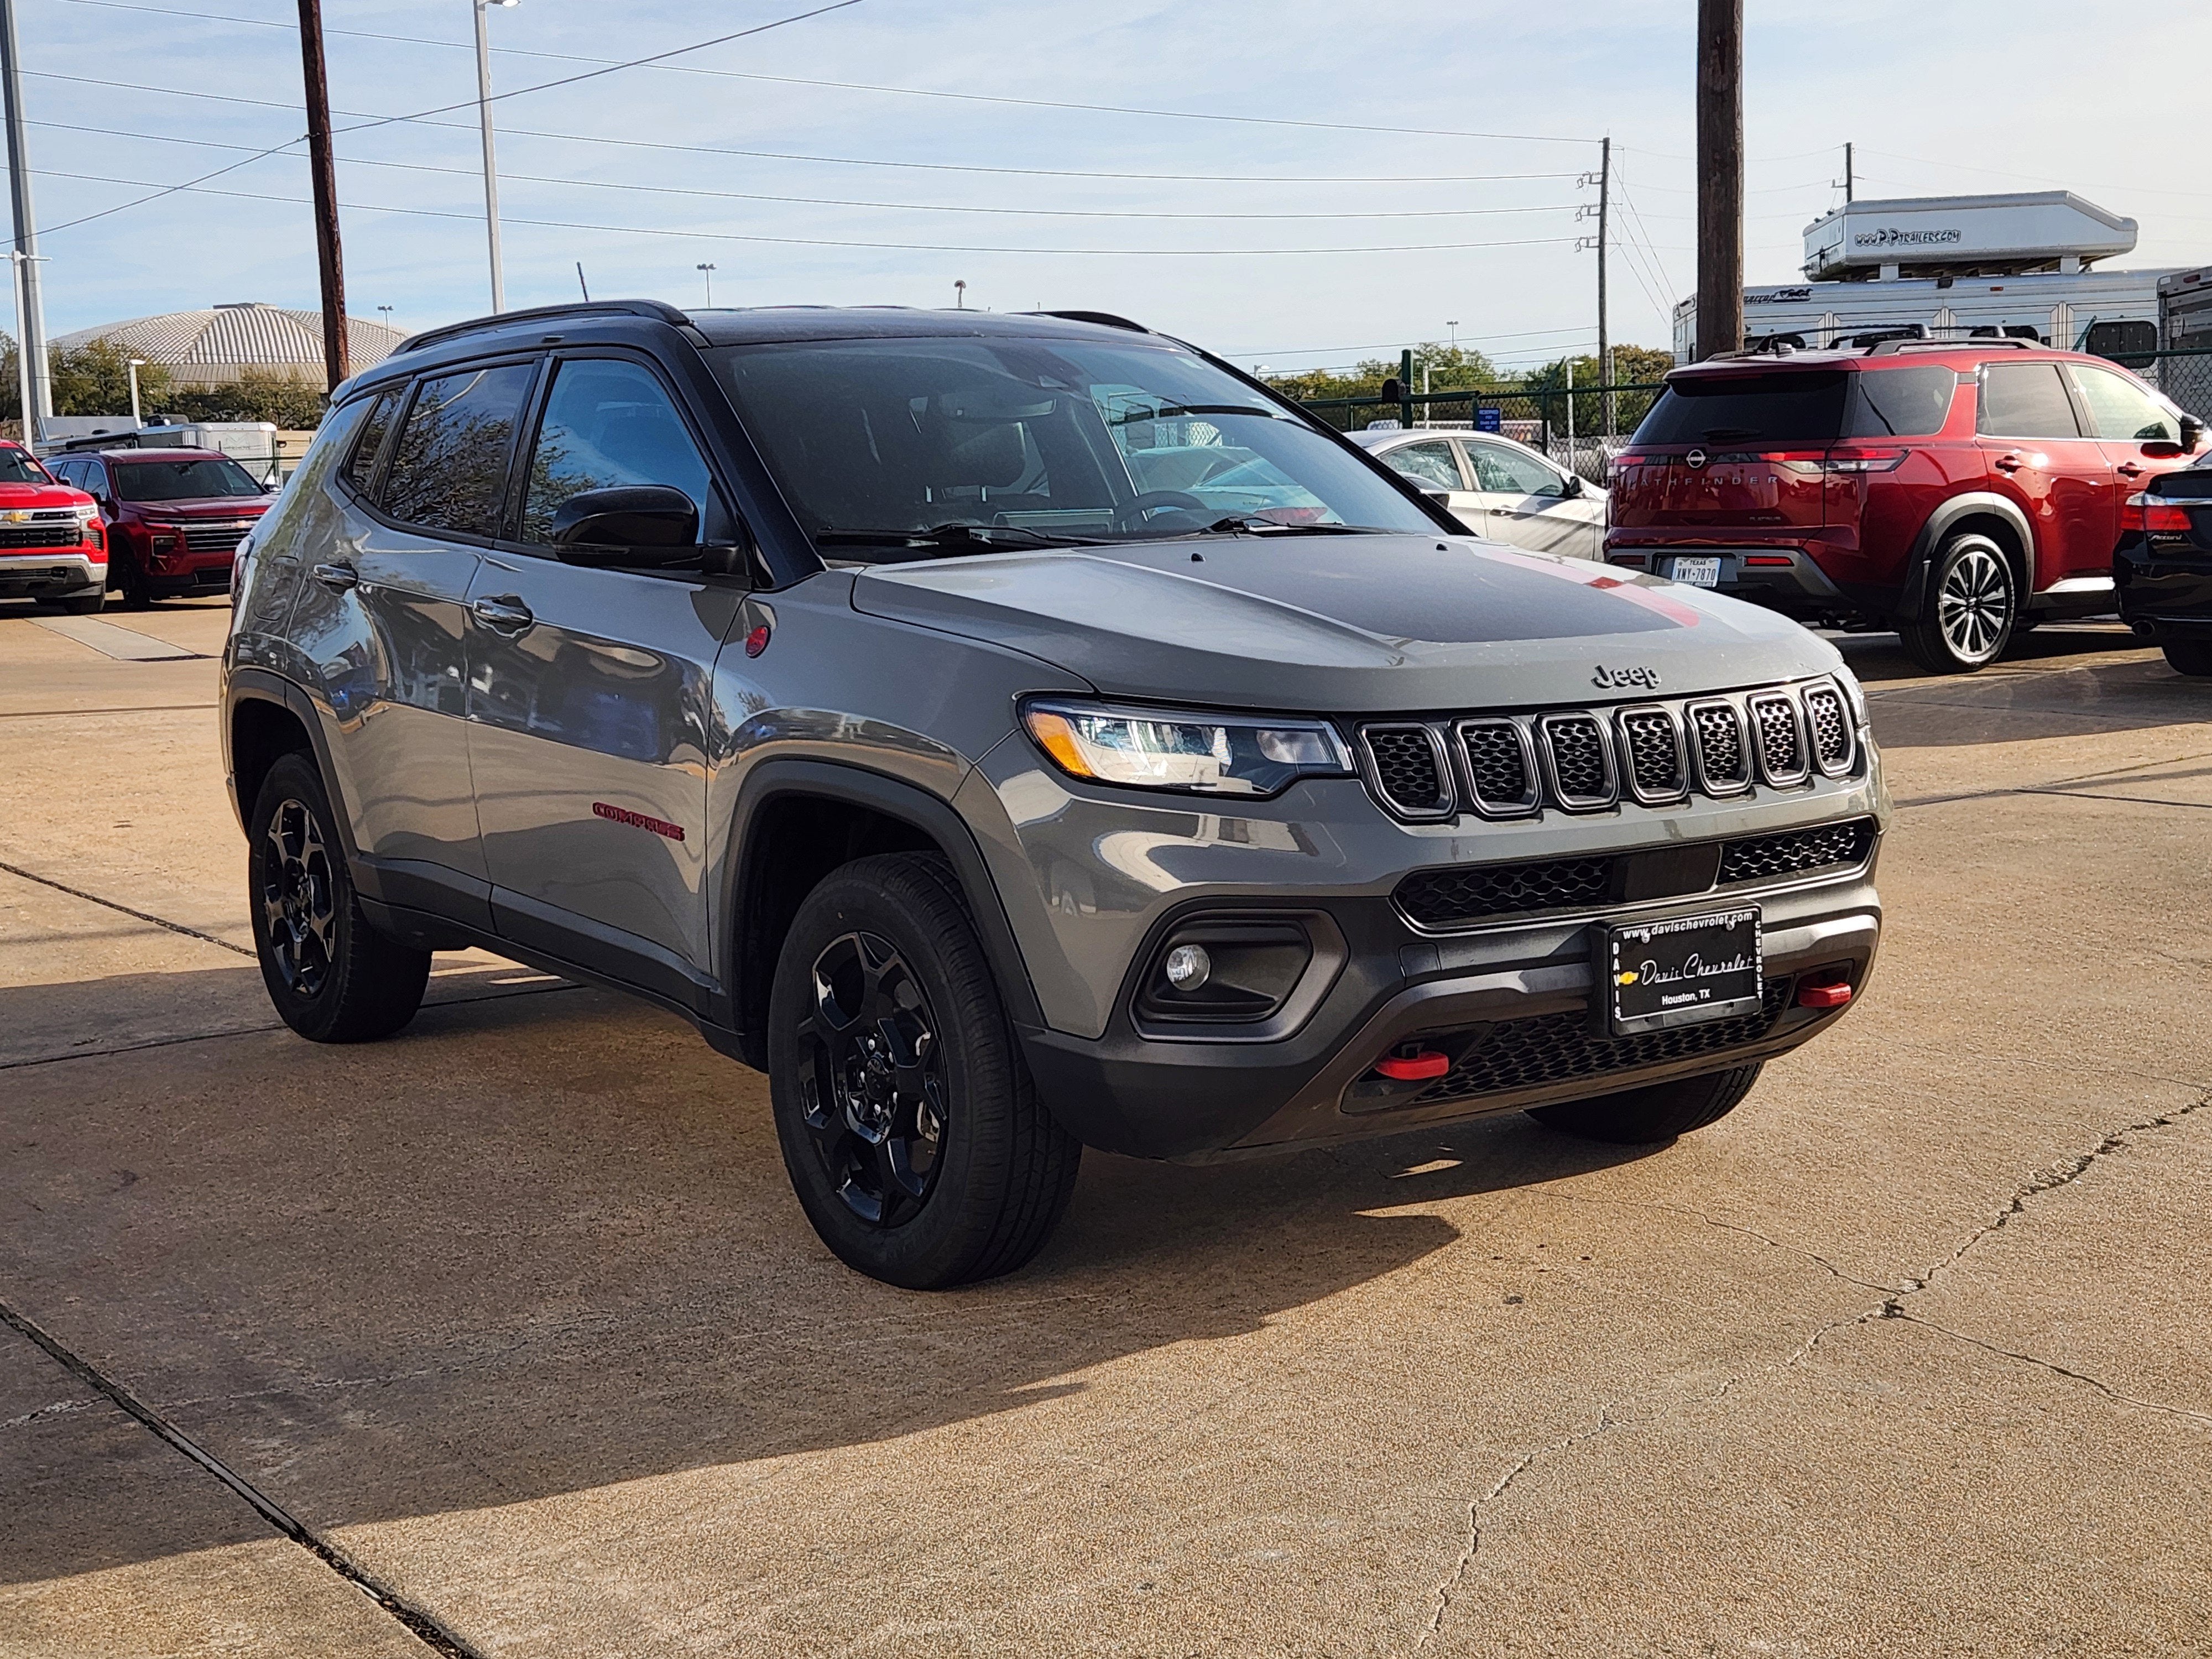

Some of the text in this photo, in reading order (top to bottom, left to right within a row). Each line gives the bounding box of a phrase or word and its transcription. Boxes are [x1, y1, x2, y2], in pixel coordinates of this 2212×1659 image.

[1590, 665, 1662, 690] Jeep
[592, 802, 685, 842] COMPASS
[1623, 912, 1752, 940] www.davischevrolet.com
[1640, 953, 1755, 985] Davis Chevrolet
[1755, 920, 1763, 999] CHEVROLET
[1613, 942, 1621, 1019] DAVIS
[1662, 988, 1710, 1005] Houston, TX
